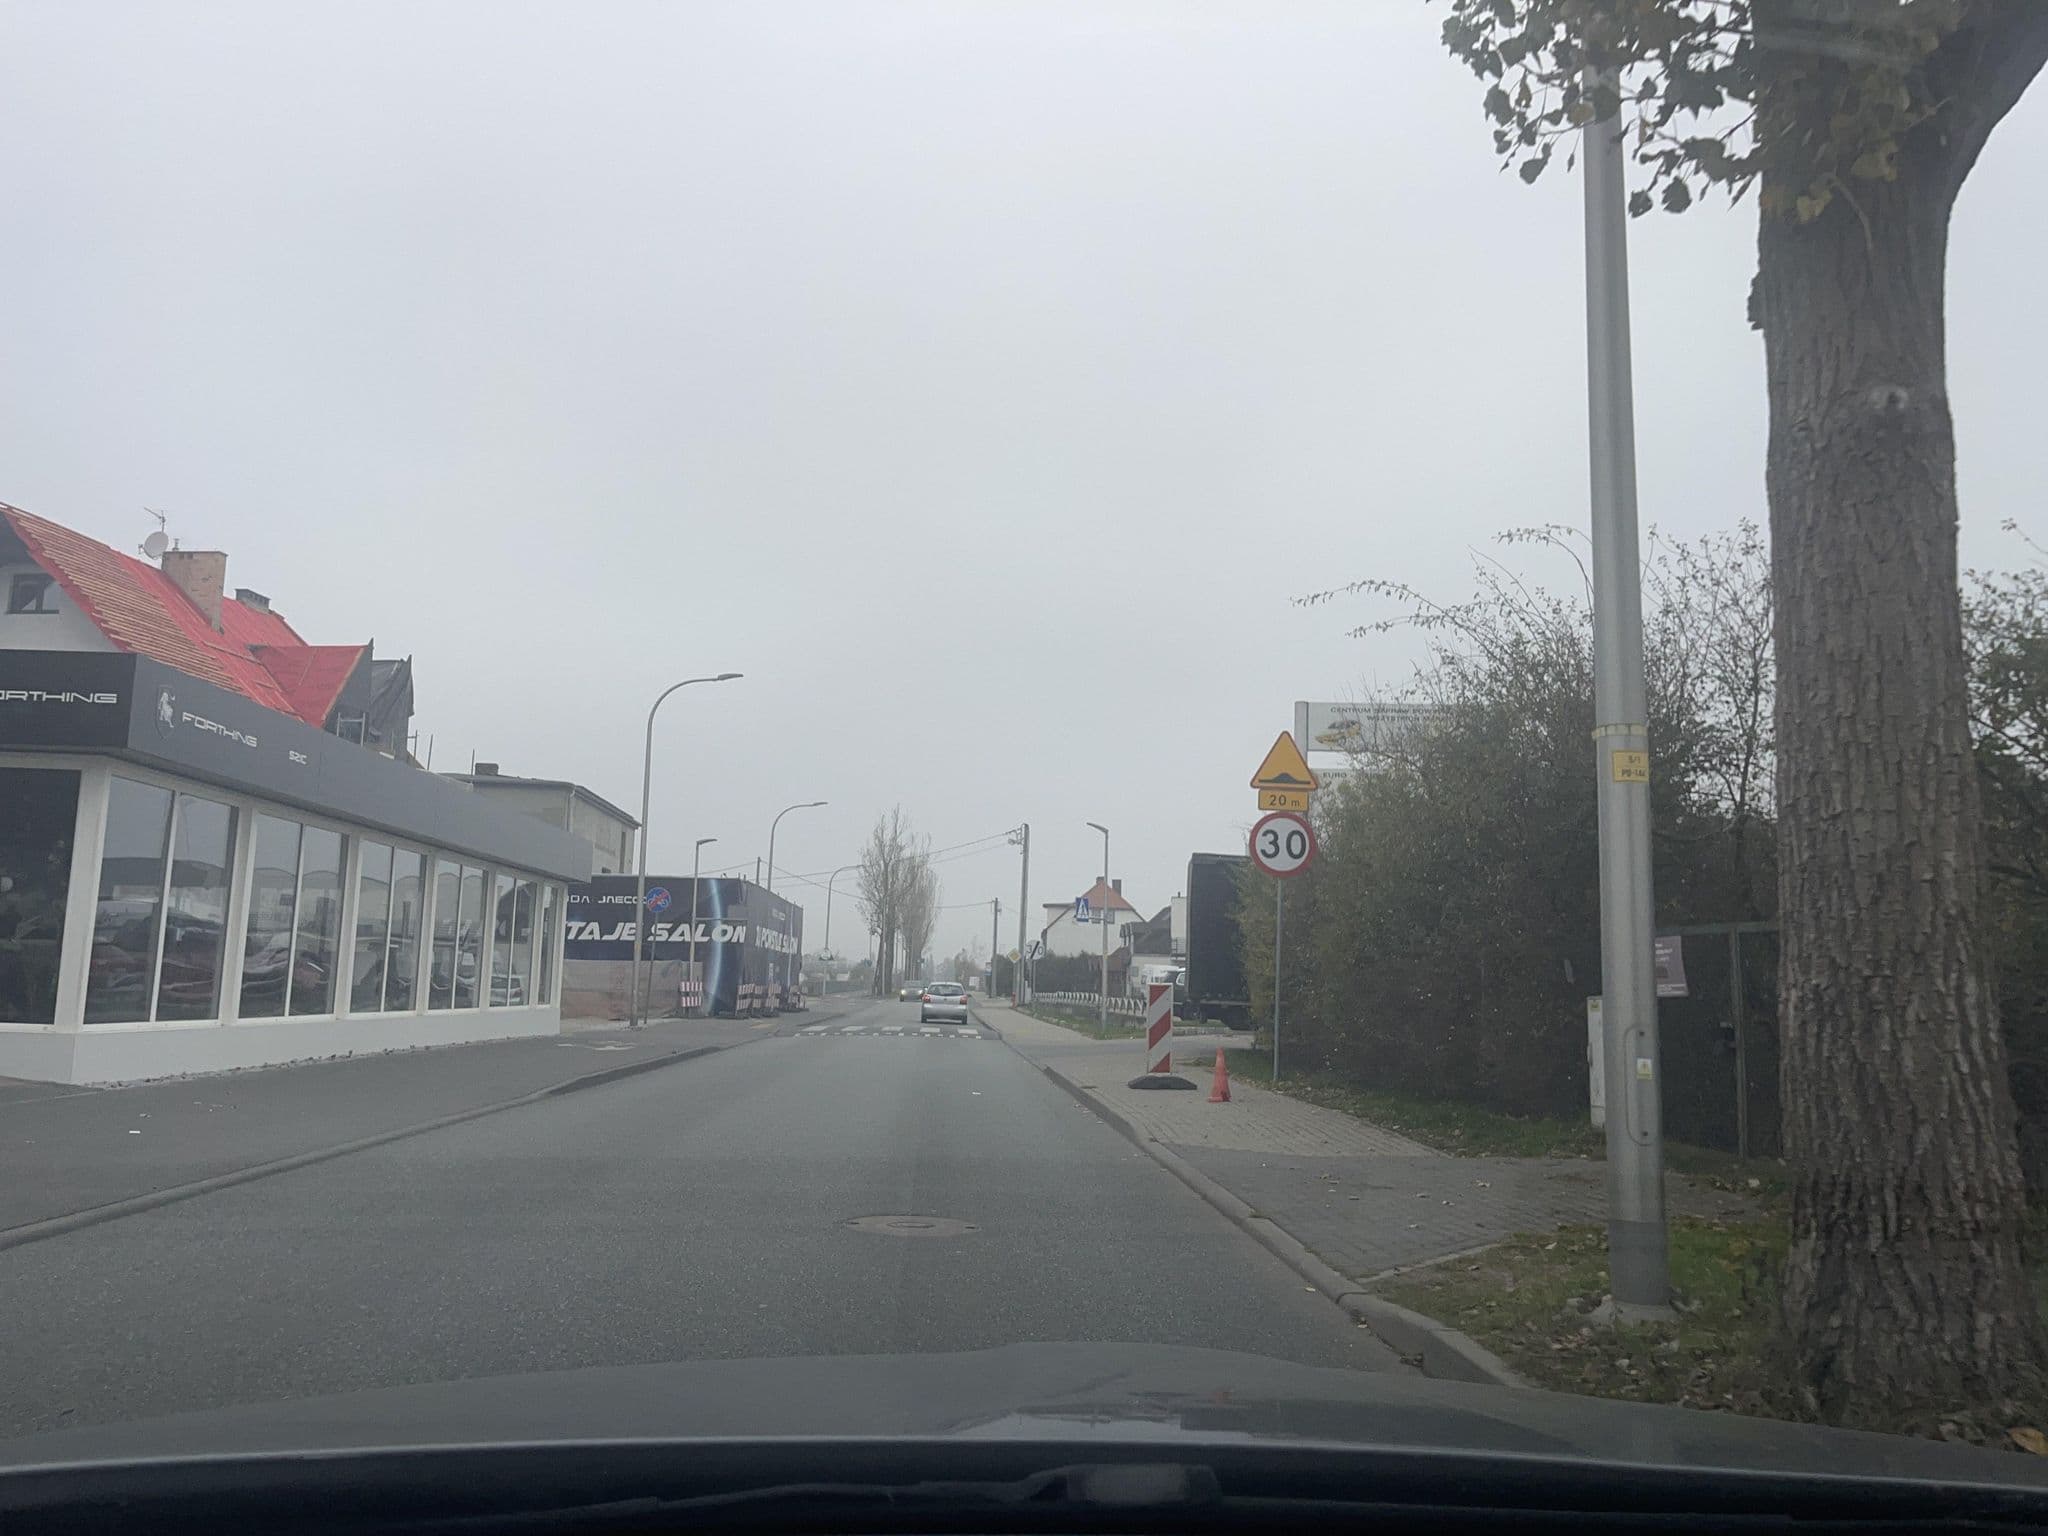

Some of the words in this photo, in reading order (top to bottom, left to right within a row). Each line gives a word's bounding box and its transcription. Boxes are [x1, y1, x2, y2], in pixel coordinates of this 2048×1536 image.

[0, 690, 117, 703] RTHING
[182, 711, 257, 747] FORTHING
[1269, 794, 1287, 806] 20
[1260, 829, 1307, 860] 30
[648, 922, 747, 944] SALON
